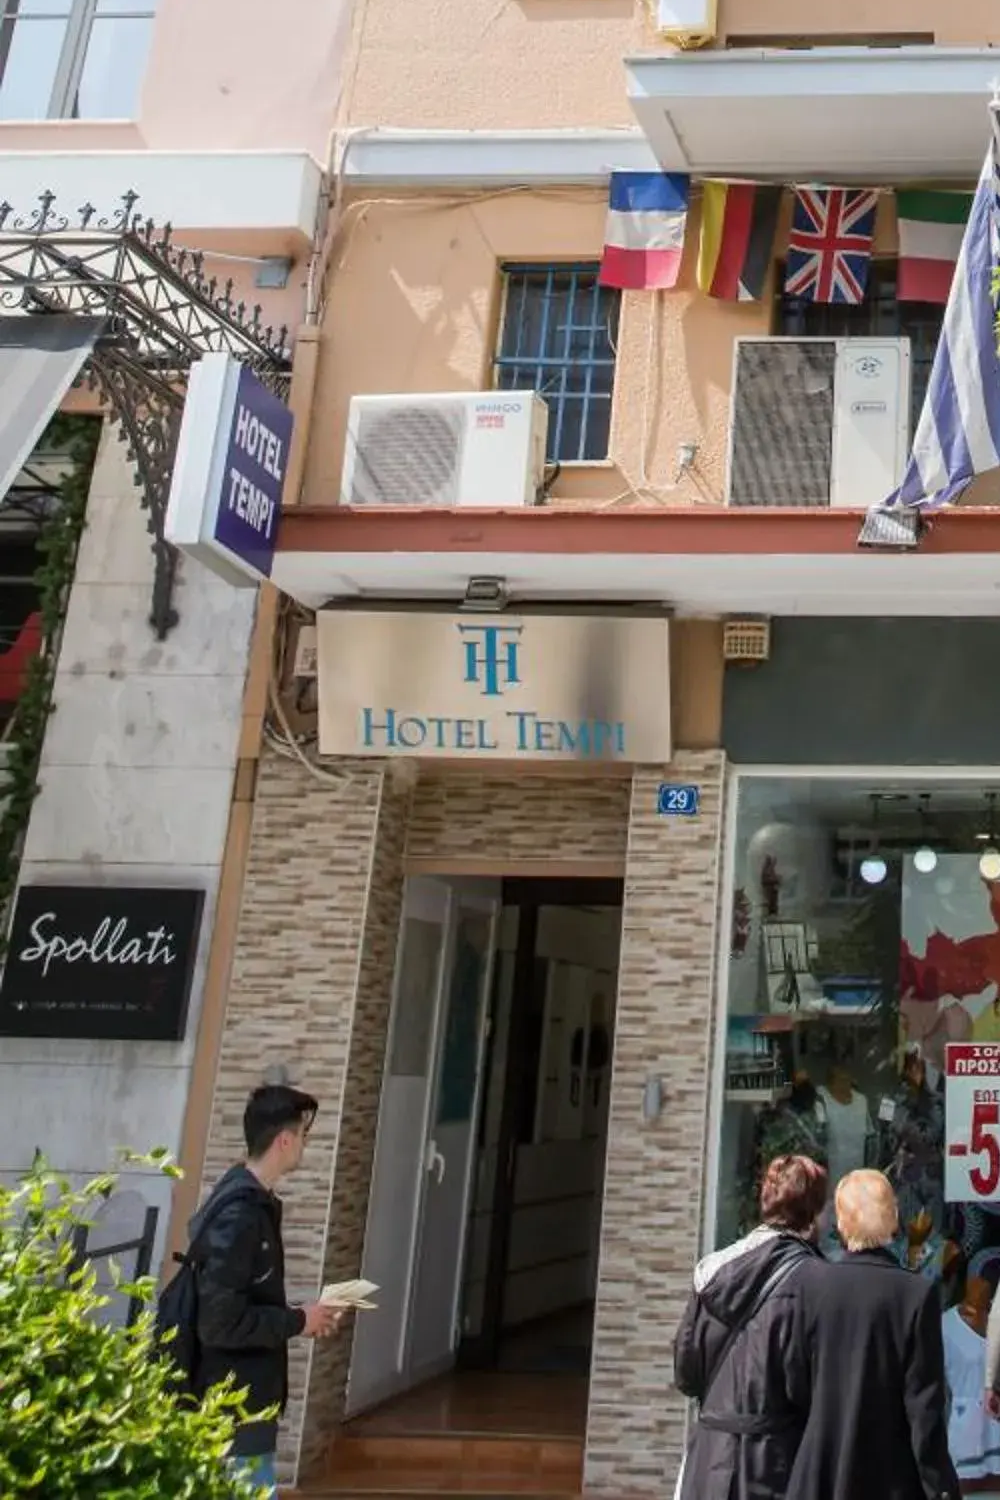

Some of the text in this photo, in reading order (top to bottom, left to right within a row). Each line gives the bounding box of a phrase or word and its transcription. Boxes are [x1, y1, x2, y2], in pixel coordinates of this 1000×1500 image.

[234, 404, 283, 481] HOTEL
[228, 467, 275, 539] TEMPI
[362, 707, 626, 755] HOTEL TEMPI
[667, 790, 688, 809] 29
[20, 911, 177, 978] Spollati
[973, 1089, 1000, 1102] ΕΩΣ
